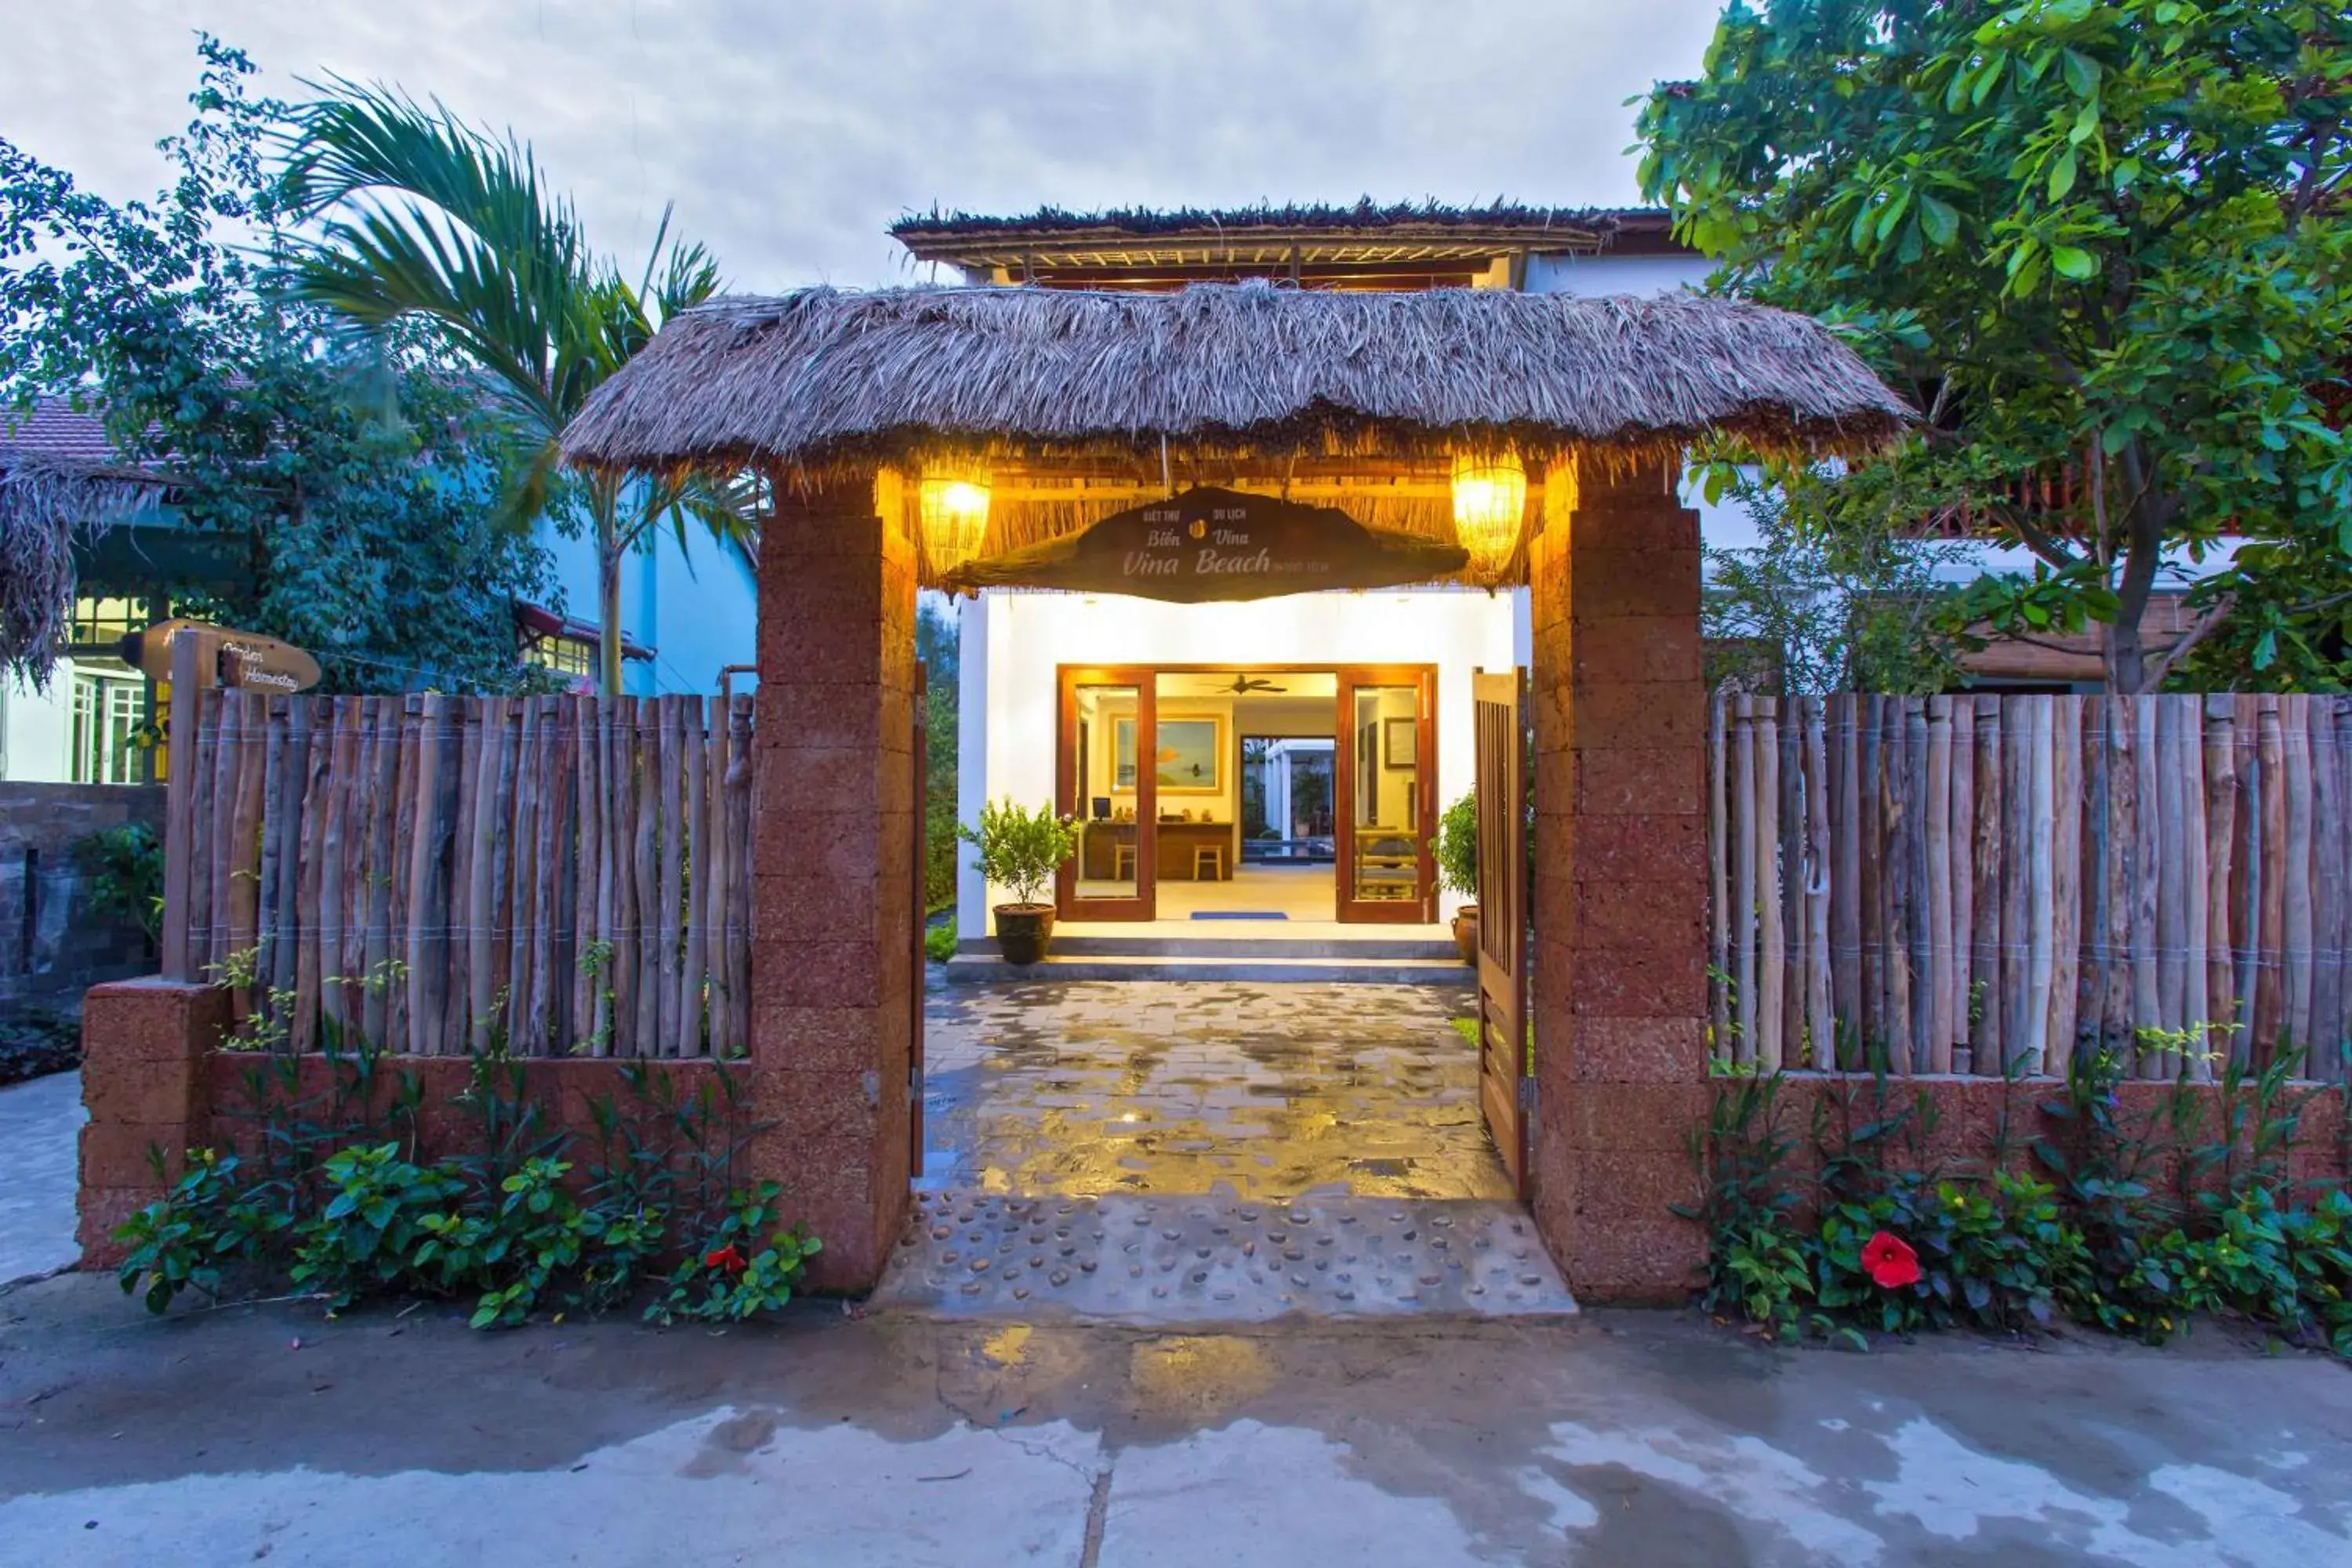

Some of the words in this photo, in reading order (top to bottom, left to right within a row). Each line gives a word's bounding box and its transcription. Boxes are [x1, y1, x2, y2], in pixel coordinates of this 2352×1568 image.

[1212, 529, 1249, 546] Vina
[1123, 551, 1180, 576] Vina
[1196, 547, 1270, 575] Beach
[245, 666, 299, 691] Homestay
